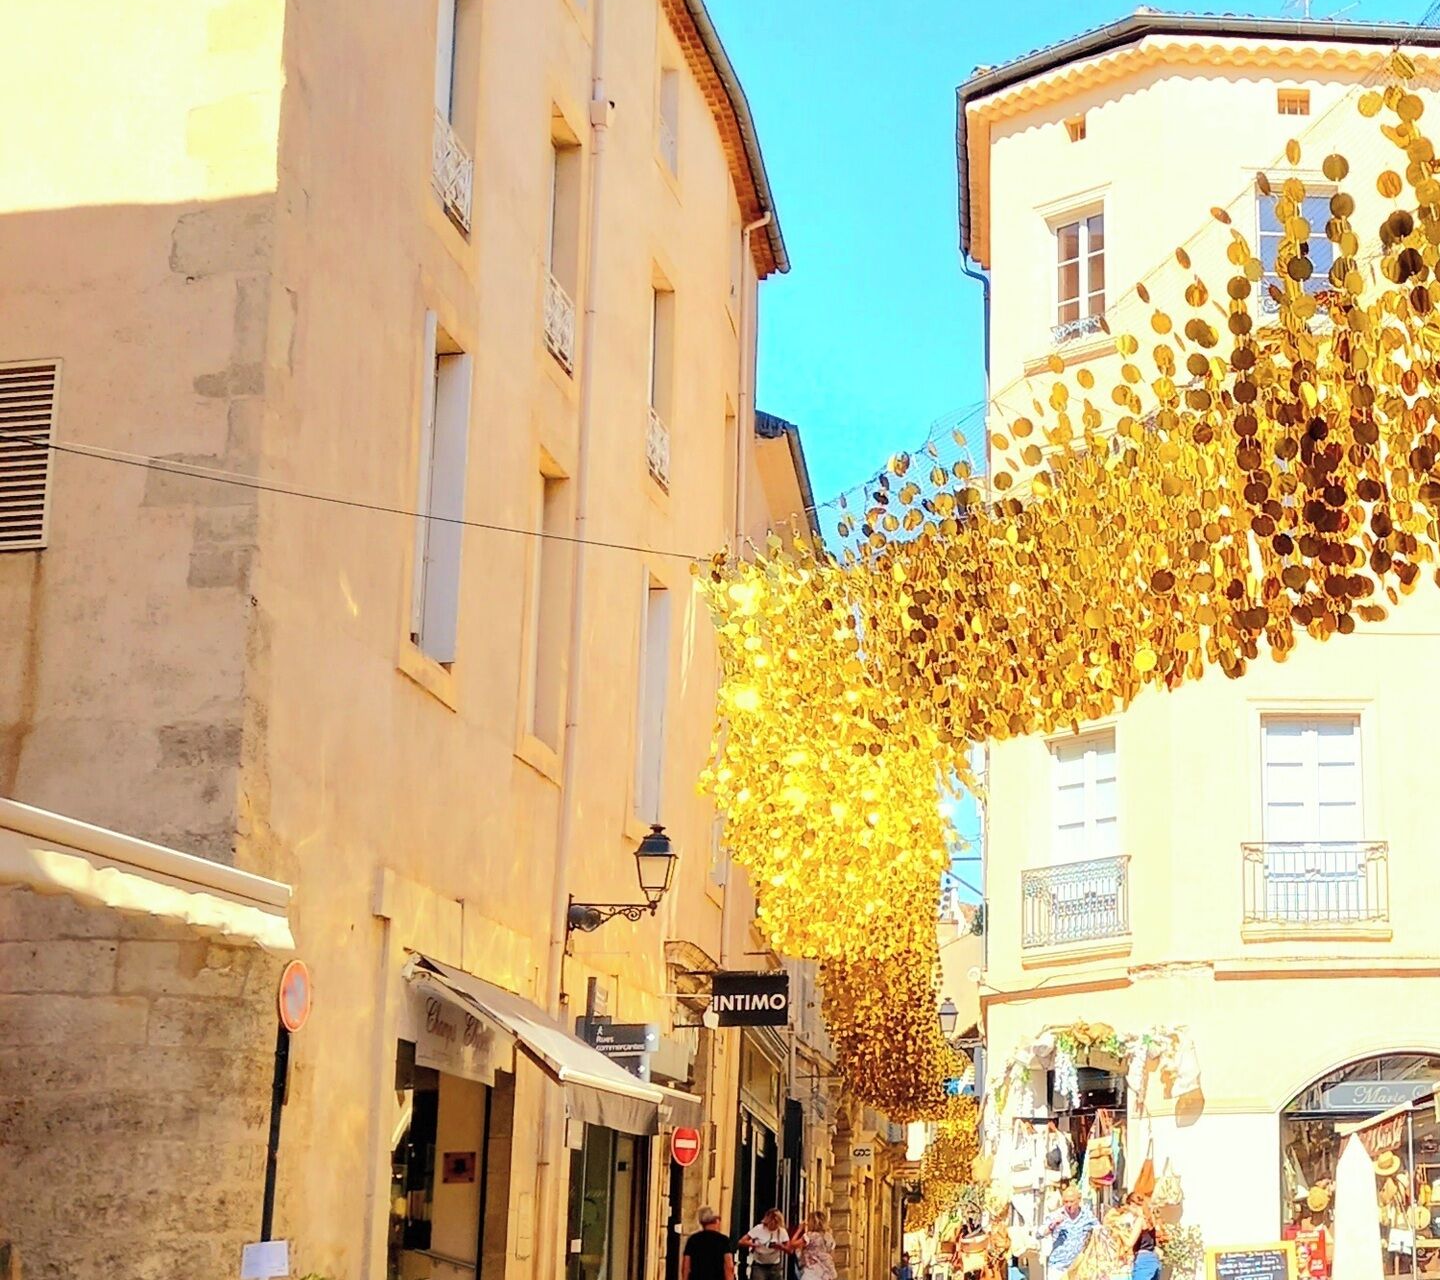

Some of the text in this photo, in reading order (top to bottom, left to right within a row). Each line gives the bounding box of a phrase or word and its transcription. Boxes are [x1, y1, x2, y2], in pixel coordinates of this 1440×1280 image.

[713, 993, 787, 1012] INTIMO
[596, 1036, 614, 1044] Rues
[595, 1043, 646, 1052] commerçantes
